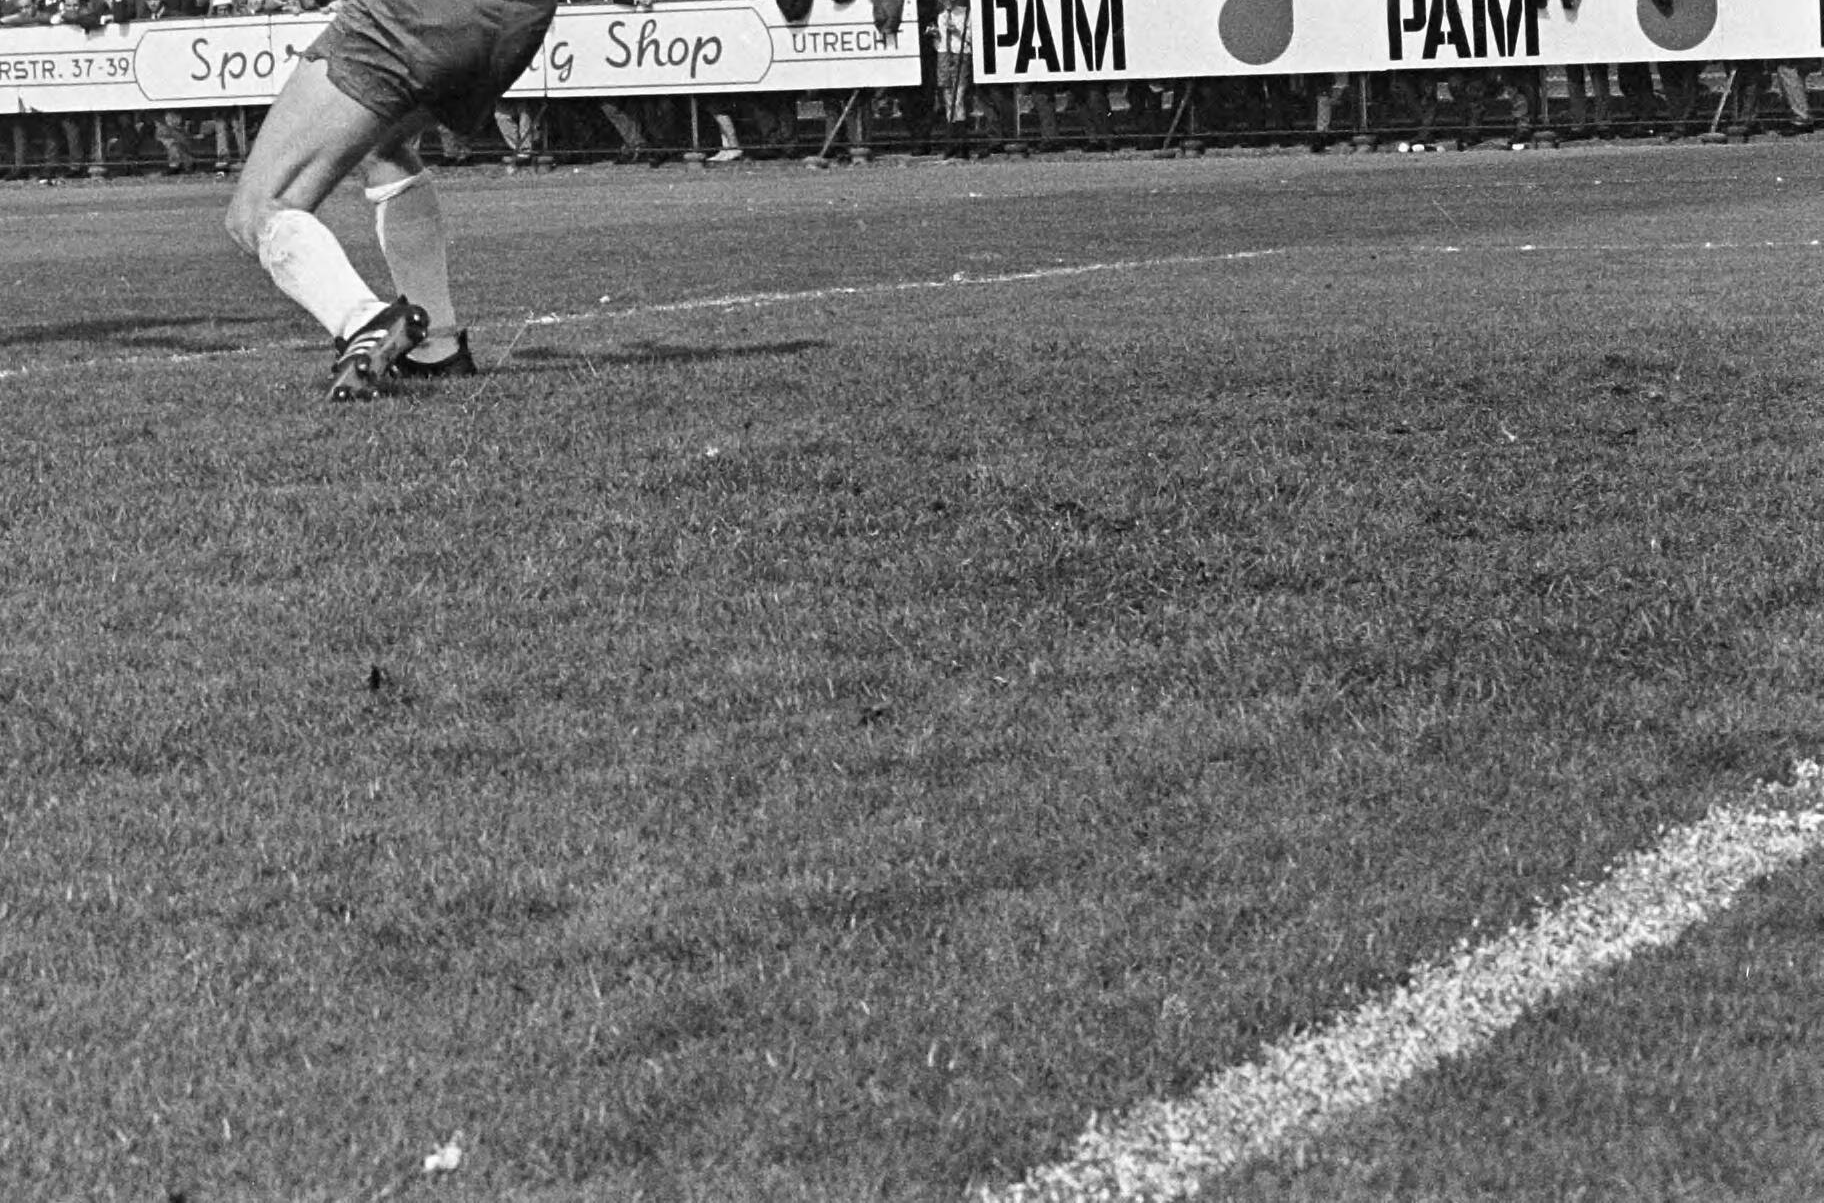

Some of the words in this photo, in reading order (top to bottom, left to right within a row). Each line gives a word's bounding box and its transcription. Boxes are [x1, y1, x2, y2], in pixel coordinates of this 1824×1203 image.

[605, 19, 723, 79] Shop
[792, 29, 904, 53] UTRECHT
[72, 57, 129, 77] 37-39
